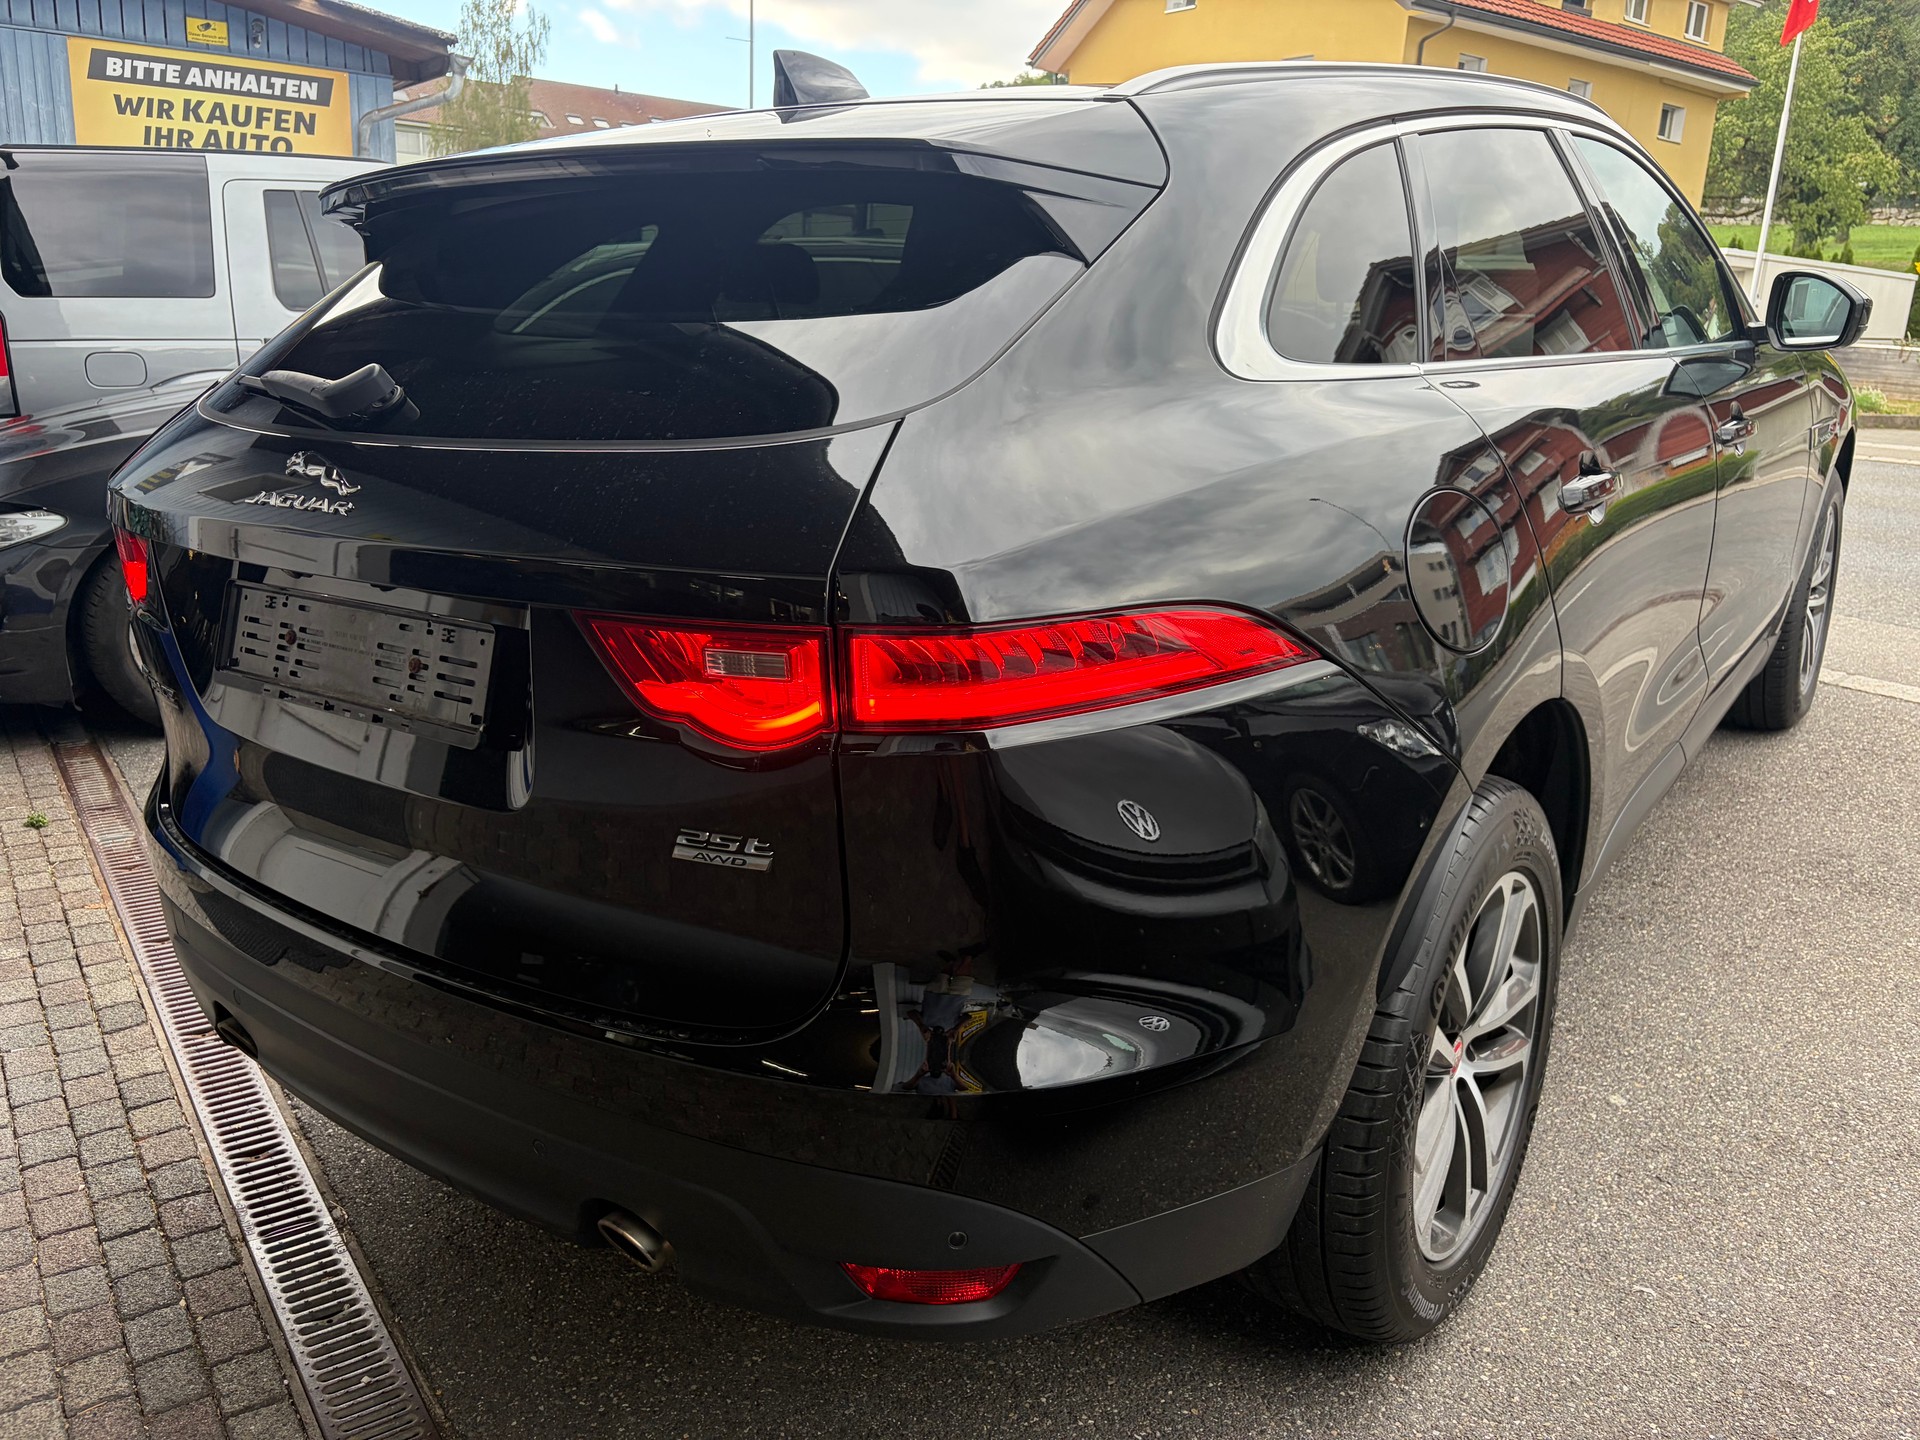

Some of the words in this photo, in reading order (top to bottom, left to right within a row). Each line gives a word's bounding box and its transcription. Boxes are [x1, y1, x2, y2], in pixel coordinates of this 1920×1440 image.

[106, 57, 181, 84] BITTE
[185, 67, 319, 100] ANHALTEN
[113, 94, 175, 121] WIR
[182, 98, 317, 136] KAUFEN
[143, 126, 194, 149] IHR
[202, 129, 293, 153] AUTO
[245, 490, 355, 517] JAGUAR
[692, 852, 748, 867] AWD
